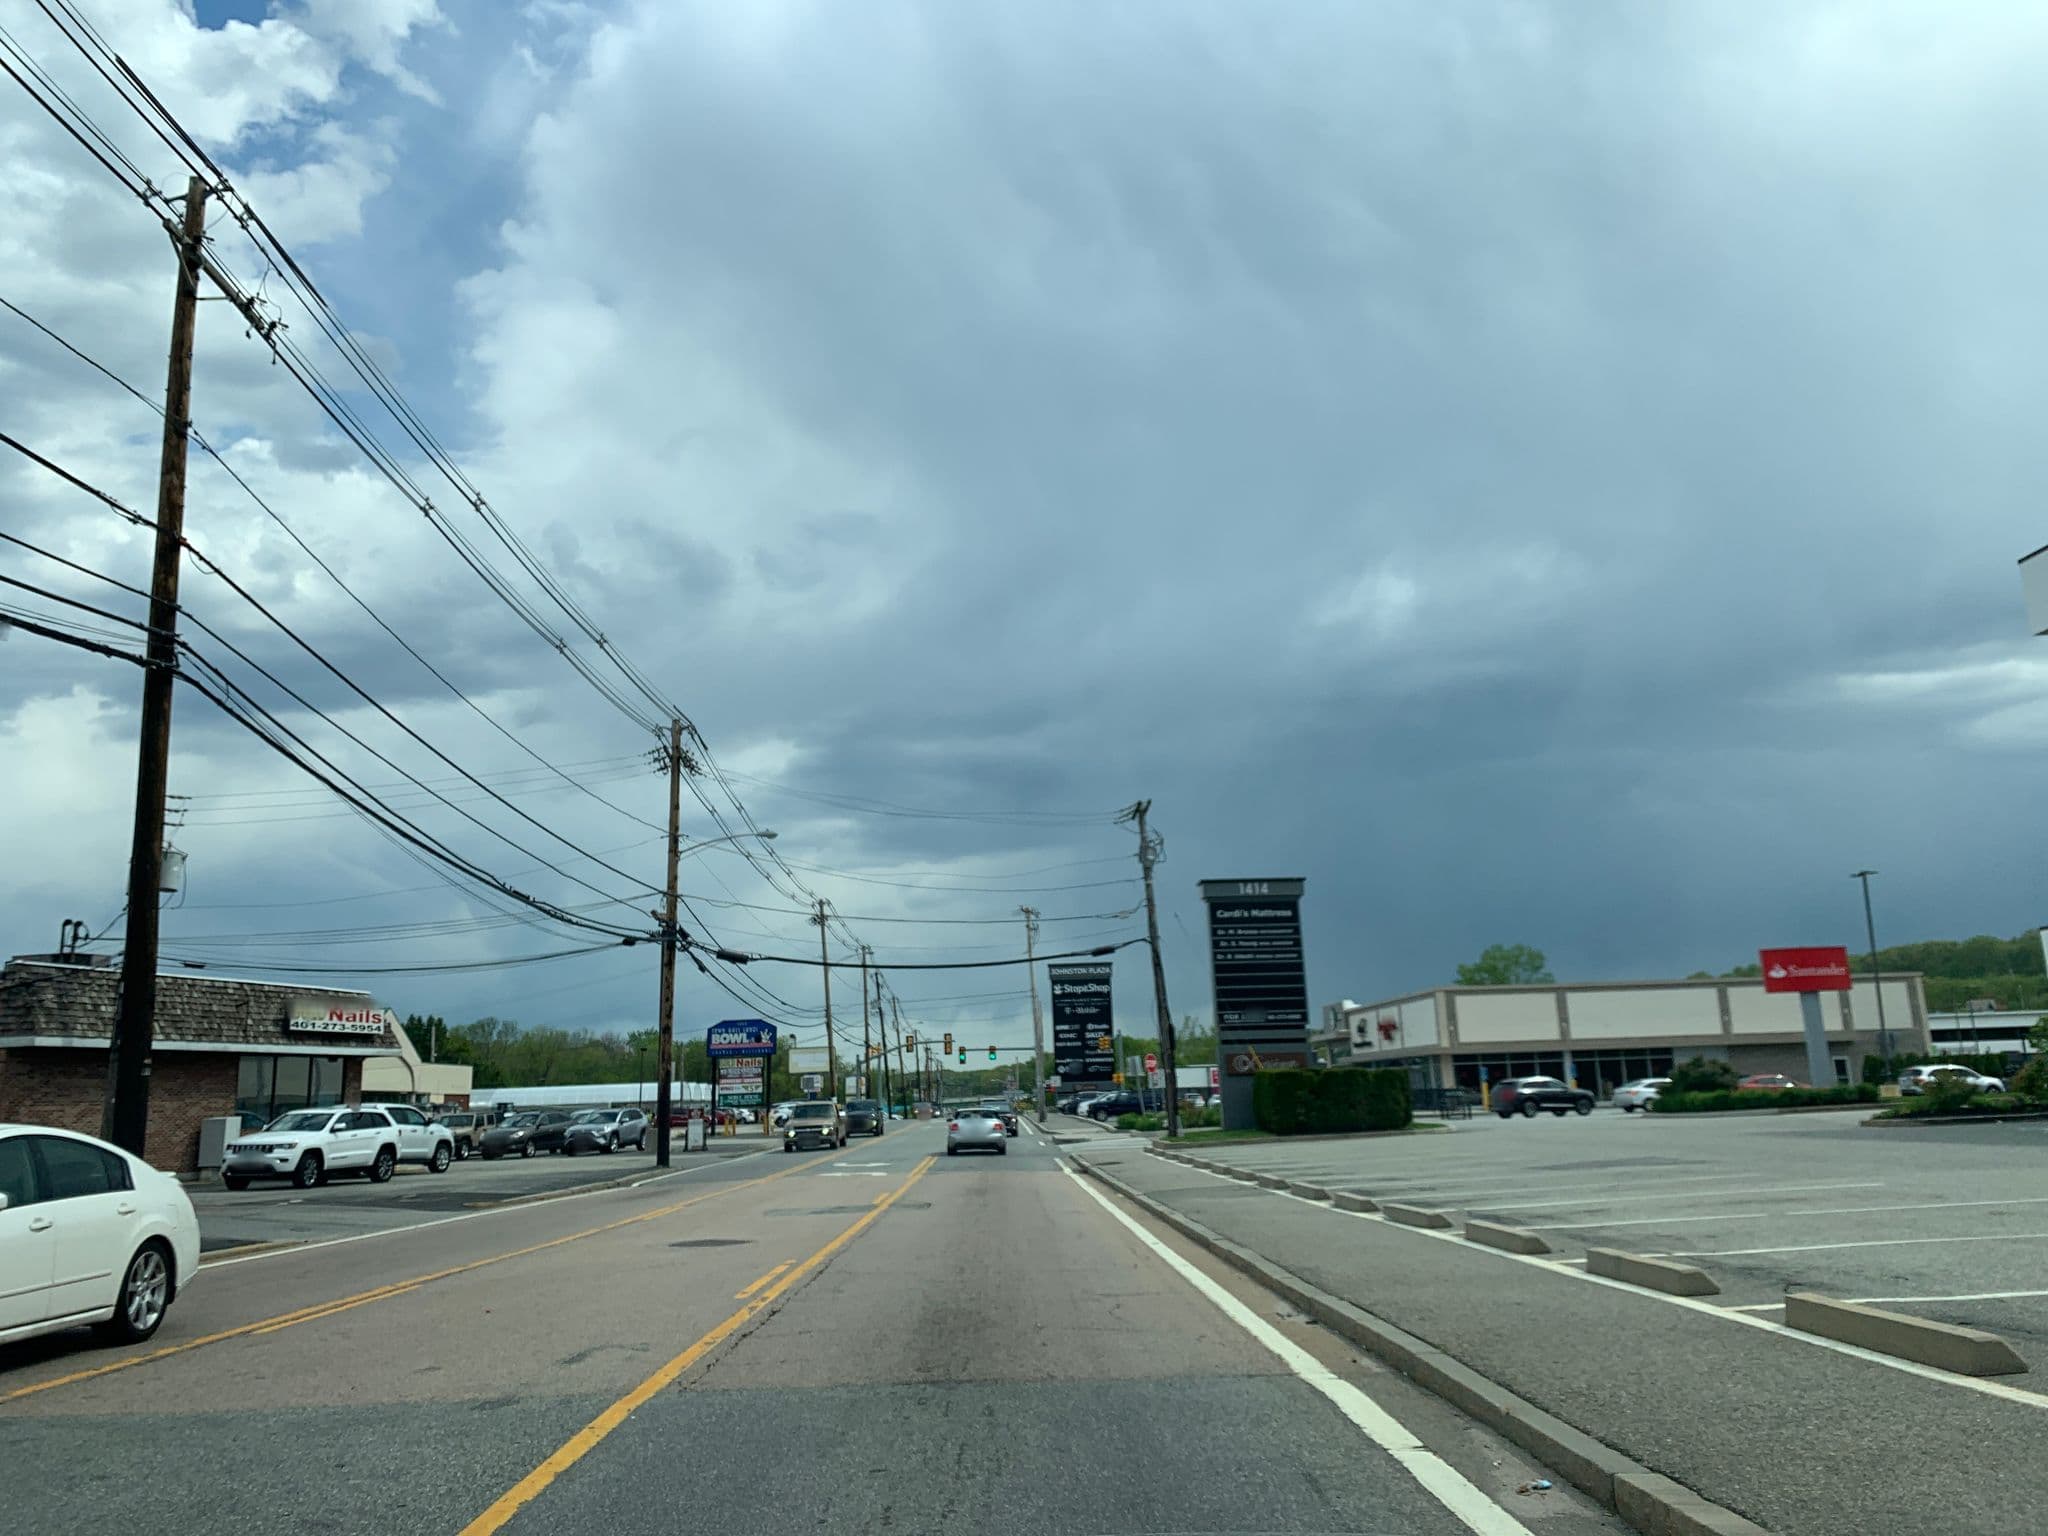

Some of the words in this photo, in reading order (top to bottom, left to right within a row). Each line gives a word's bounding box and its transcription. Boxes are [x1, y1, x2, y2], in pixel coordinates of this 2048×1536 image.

[1240, 882, 1268, 894] 1414
[1217, 909, 1249, 918] Cardi's
[1251, 908, 1292, 917] Mattress
[1052, 967, 1087, 975] JOHNSTON
[1088, 966, 1111, 974] PLAZA
[1787, 962, 1847, 977] Santander
[328, 1008, 382, 1024] Nails
[291, 1020, 382, 1032] 401-273-5954
[711, 1033, 748, 1044] BOWL
[736, 1058, 762, 1066] Nails
